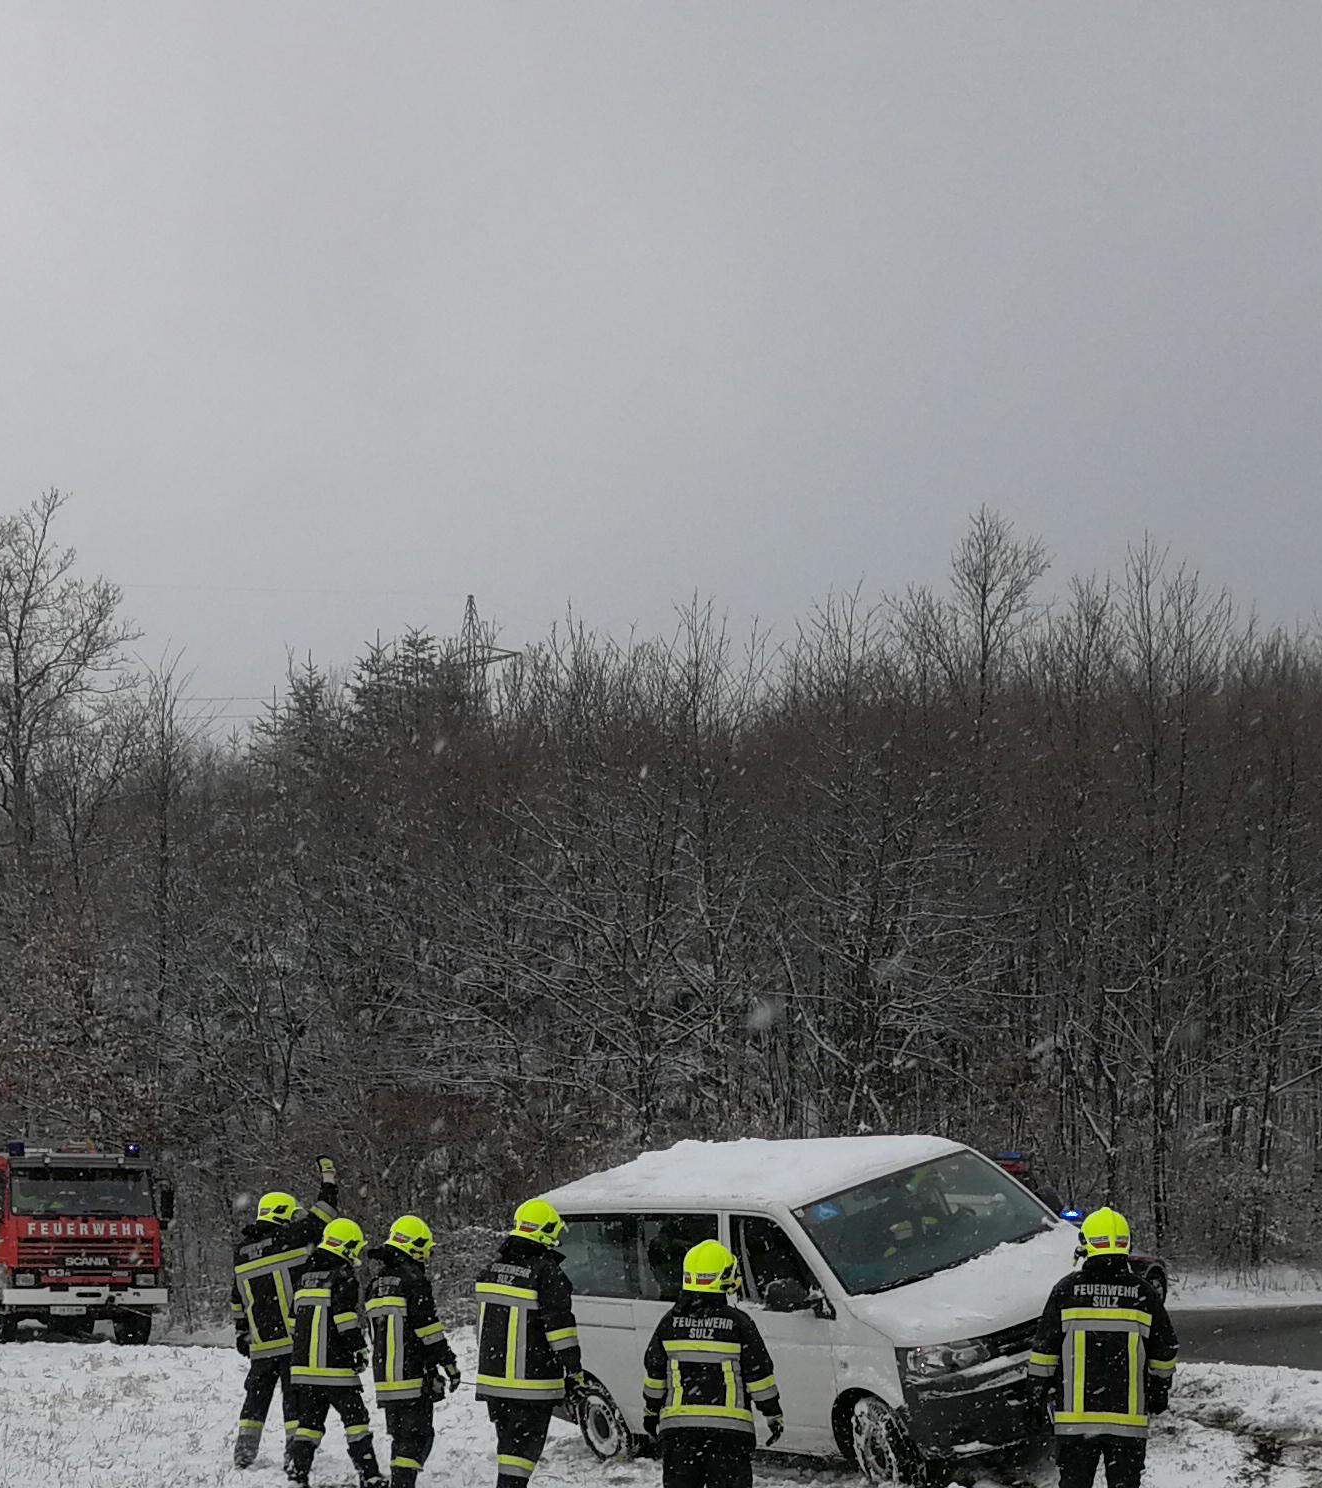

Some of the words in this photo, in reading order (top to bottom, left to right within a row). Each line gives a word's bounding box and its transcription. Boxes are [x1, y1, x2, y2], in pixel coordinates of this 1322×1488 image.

[27, 1222, 145, 1236] FEUERWEHR
[64, 1257, 110, 1266] SCANIA
[1073, 1283, 1139, 1298] FEUERWEHR
[1092, 1295, 1119, 1308] SULZ
[672, 1316, 734, 1331] FEUERWEHR
[689, 1328, 715, 1339] SULZ
